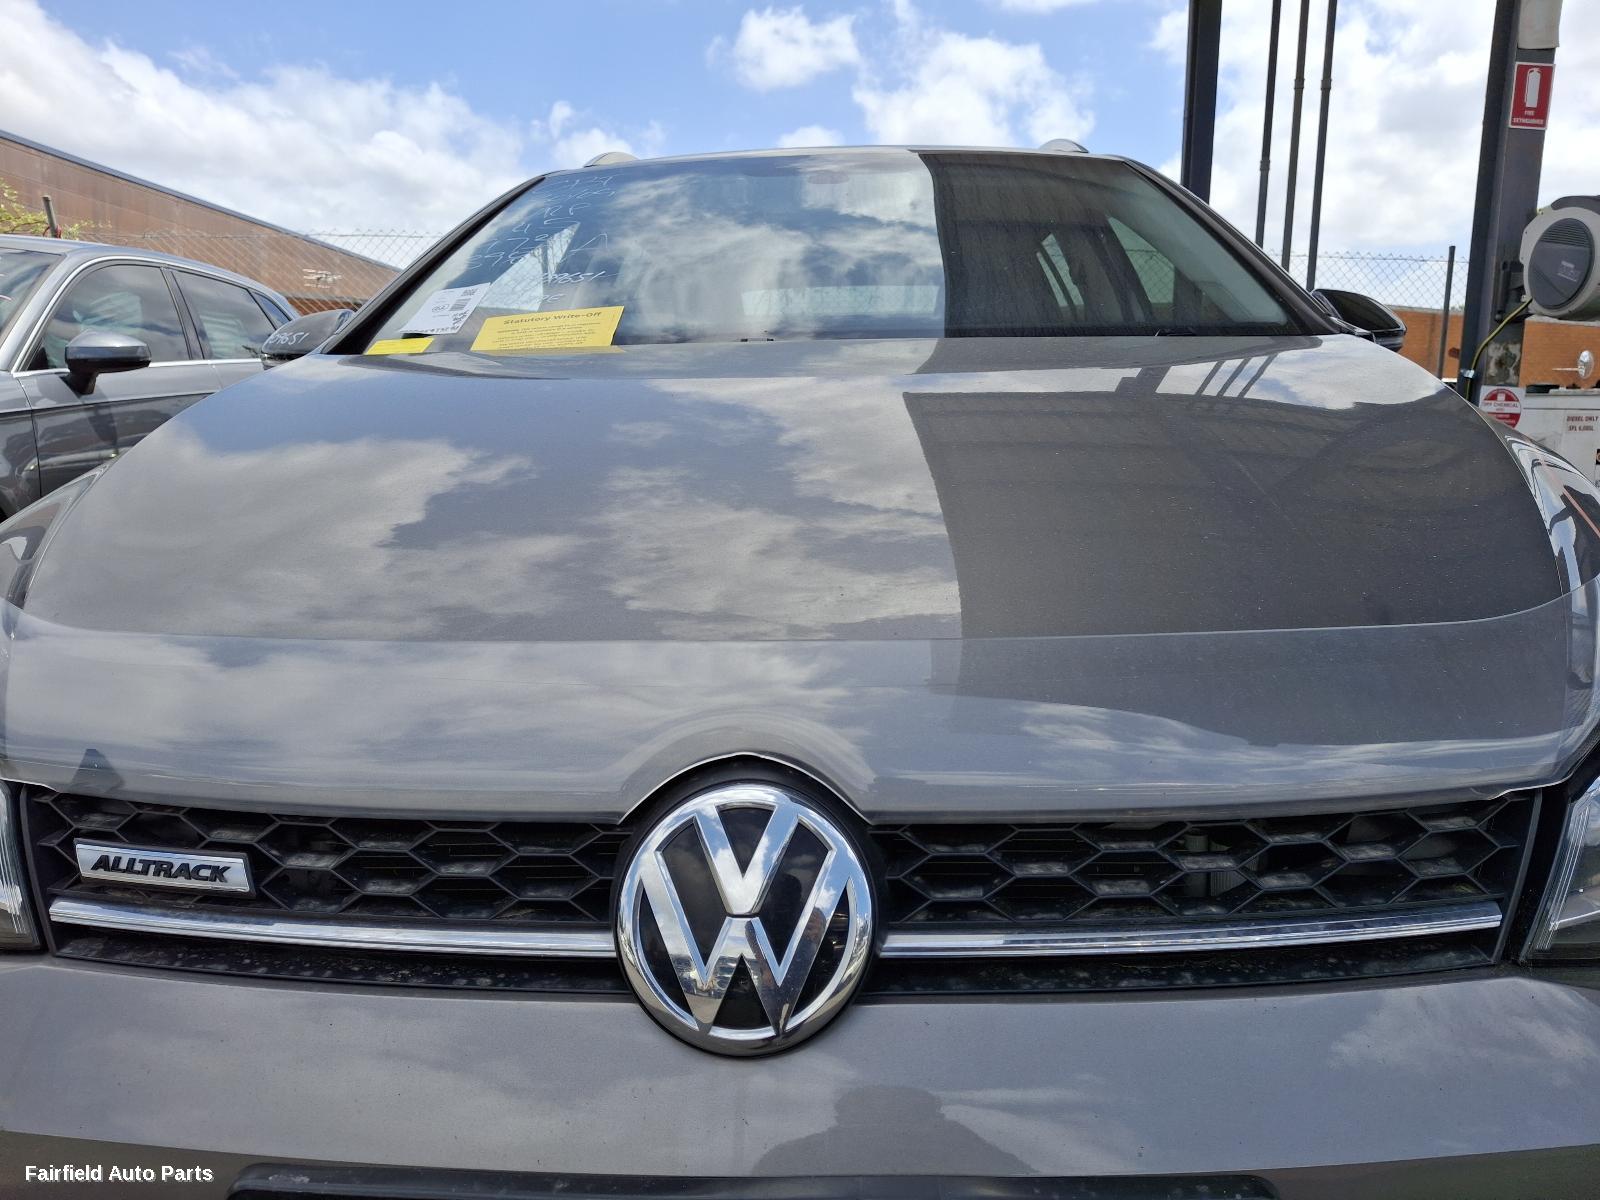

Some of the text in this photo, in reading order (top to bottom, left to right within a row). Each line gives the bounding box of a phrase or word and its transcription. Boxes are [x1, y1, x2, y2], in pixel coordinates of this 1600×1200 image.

[503, 311, 602, 325] Statutory Write-Off
[91, 854, 229, 883] ALLTRACK
